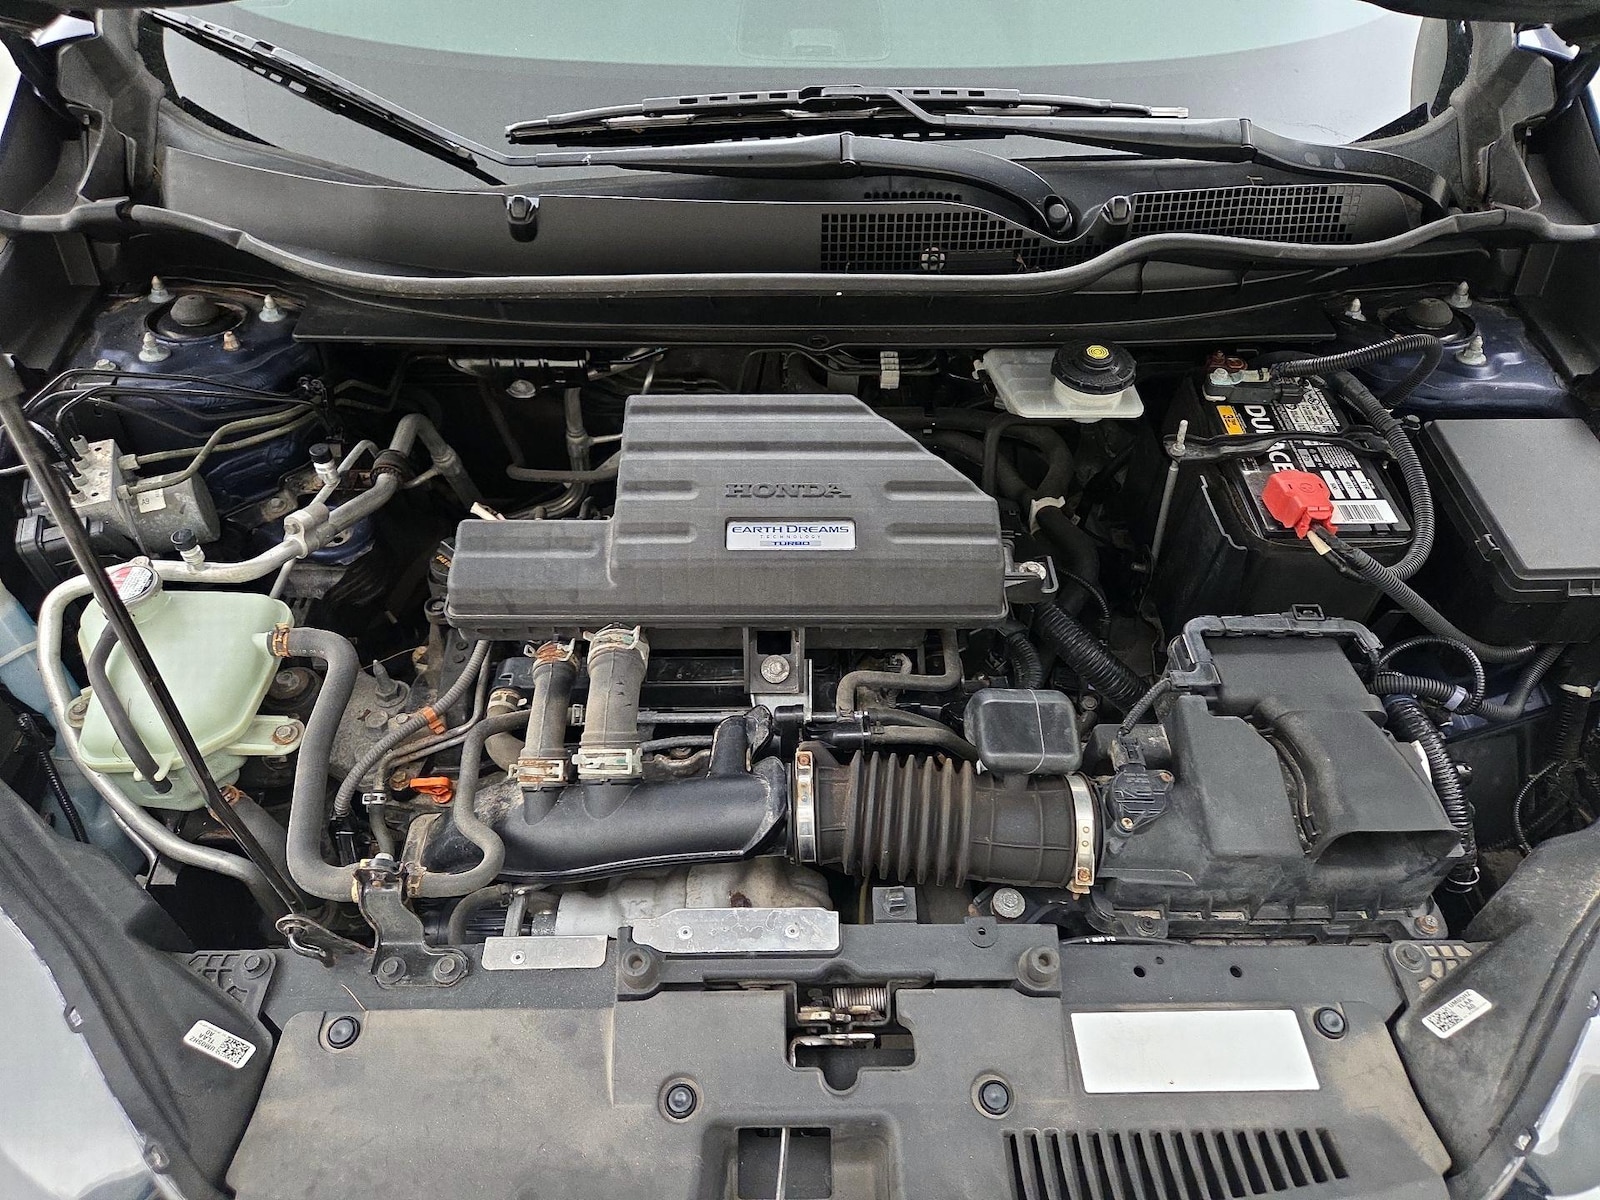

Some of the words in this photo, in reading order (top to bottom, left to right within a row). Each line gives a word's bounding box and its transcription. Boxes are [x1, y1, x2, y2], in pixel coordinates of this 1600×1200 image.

[725, 483, 852, 498] HONDA
[732, 525, 783, 533] EARTH
[786, 525, 849, 533] DREAMS
